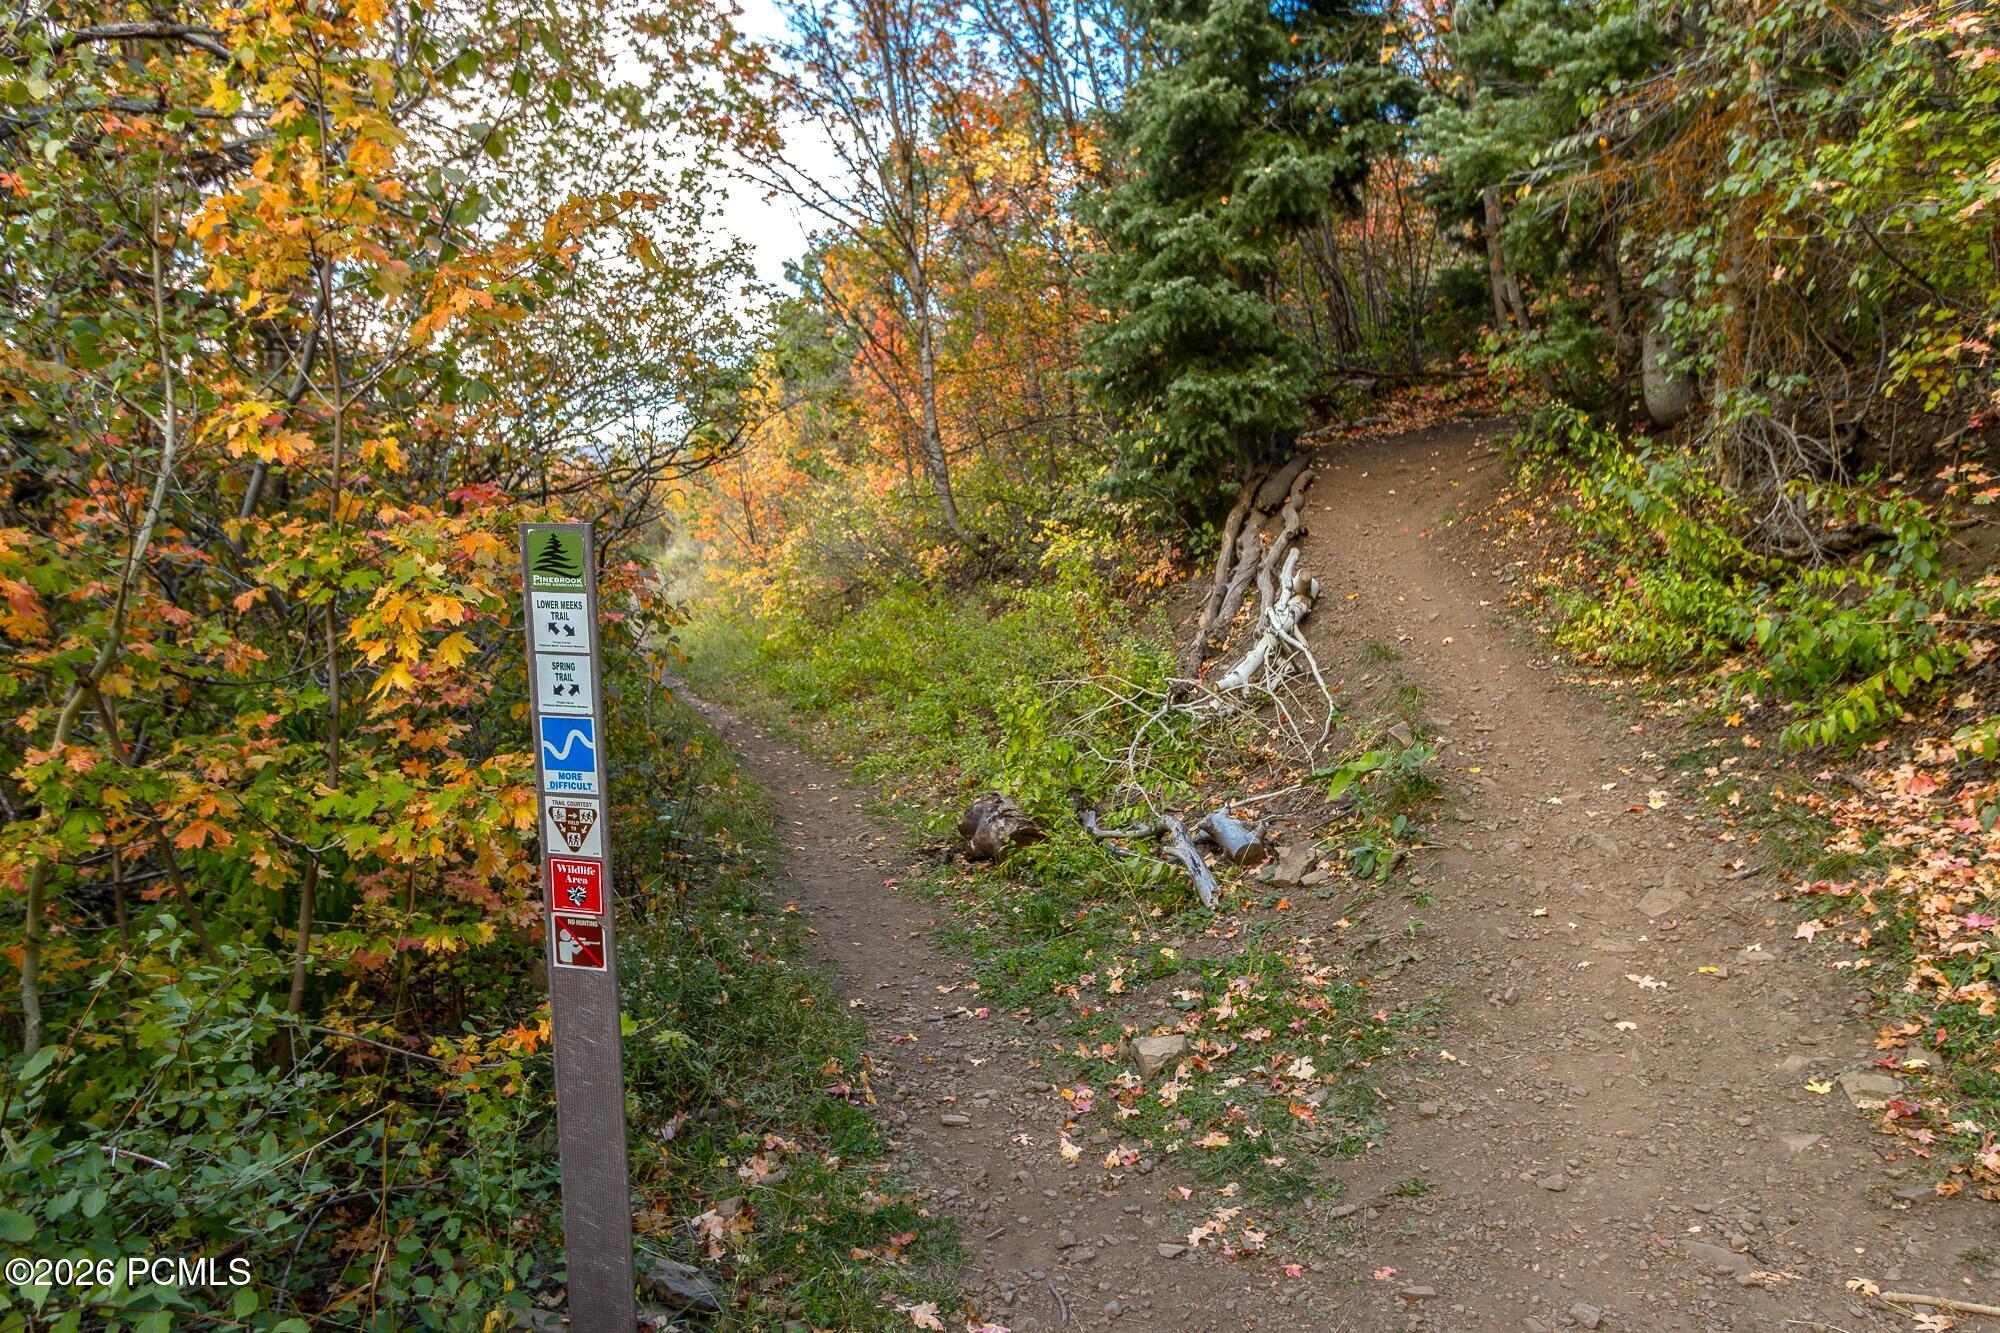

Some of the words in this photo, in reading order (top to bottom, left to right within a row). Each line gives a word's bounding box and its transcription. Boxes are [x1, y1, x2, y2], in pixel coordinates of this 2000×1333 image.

[533, 575, 582, 584] PINEBROOK
[537, 600, 559, 609] LOWER
[560, 600, 583, 610] MEEKS
[551, 612, 570, 621] TRAIL
[552, 661, 575, 671] SPRING
[555, 673, 574, 682] TRAIL
[558, 772, 583, 780] MORE
[550, 781, 592, 790] DIFFICULT
[556, 863, 596, 876] Wildlife
[565, 874, 588, 884] Area
[576, 919, 598, 927] HUNTING
